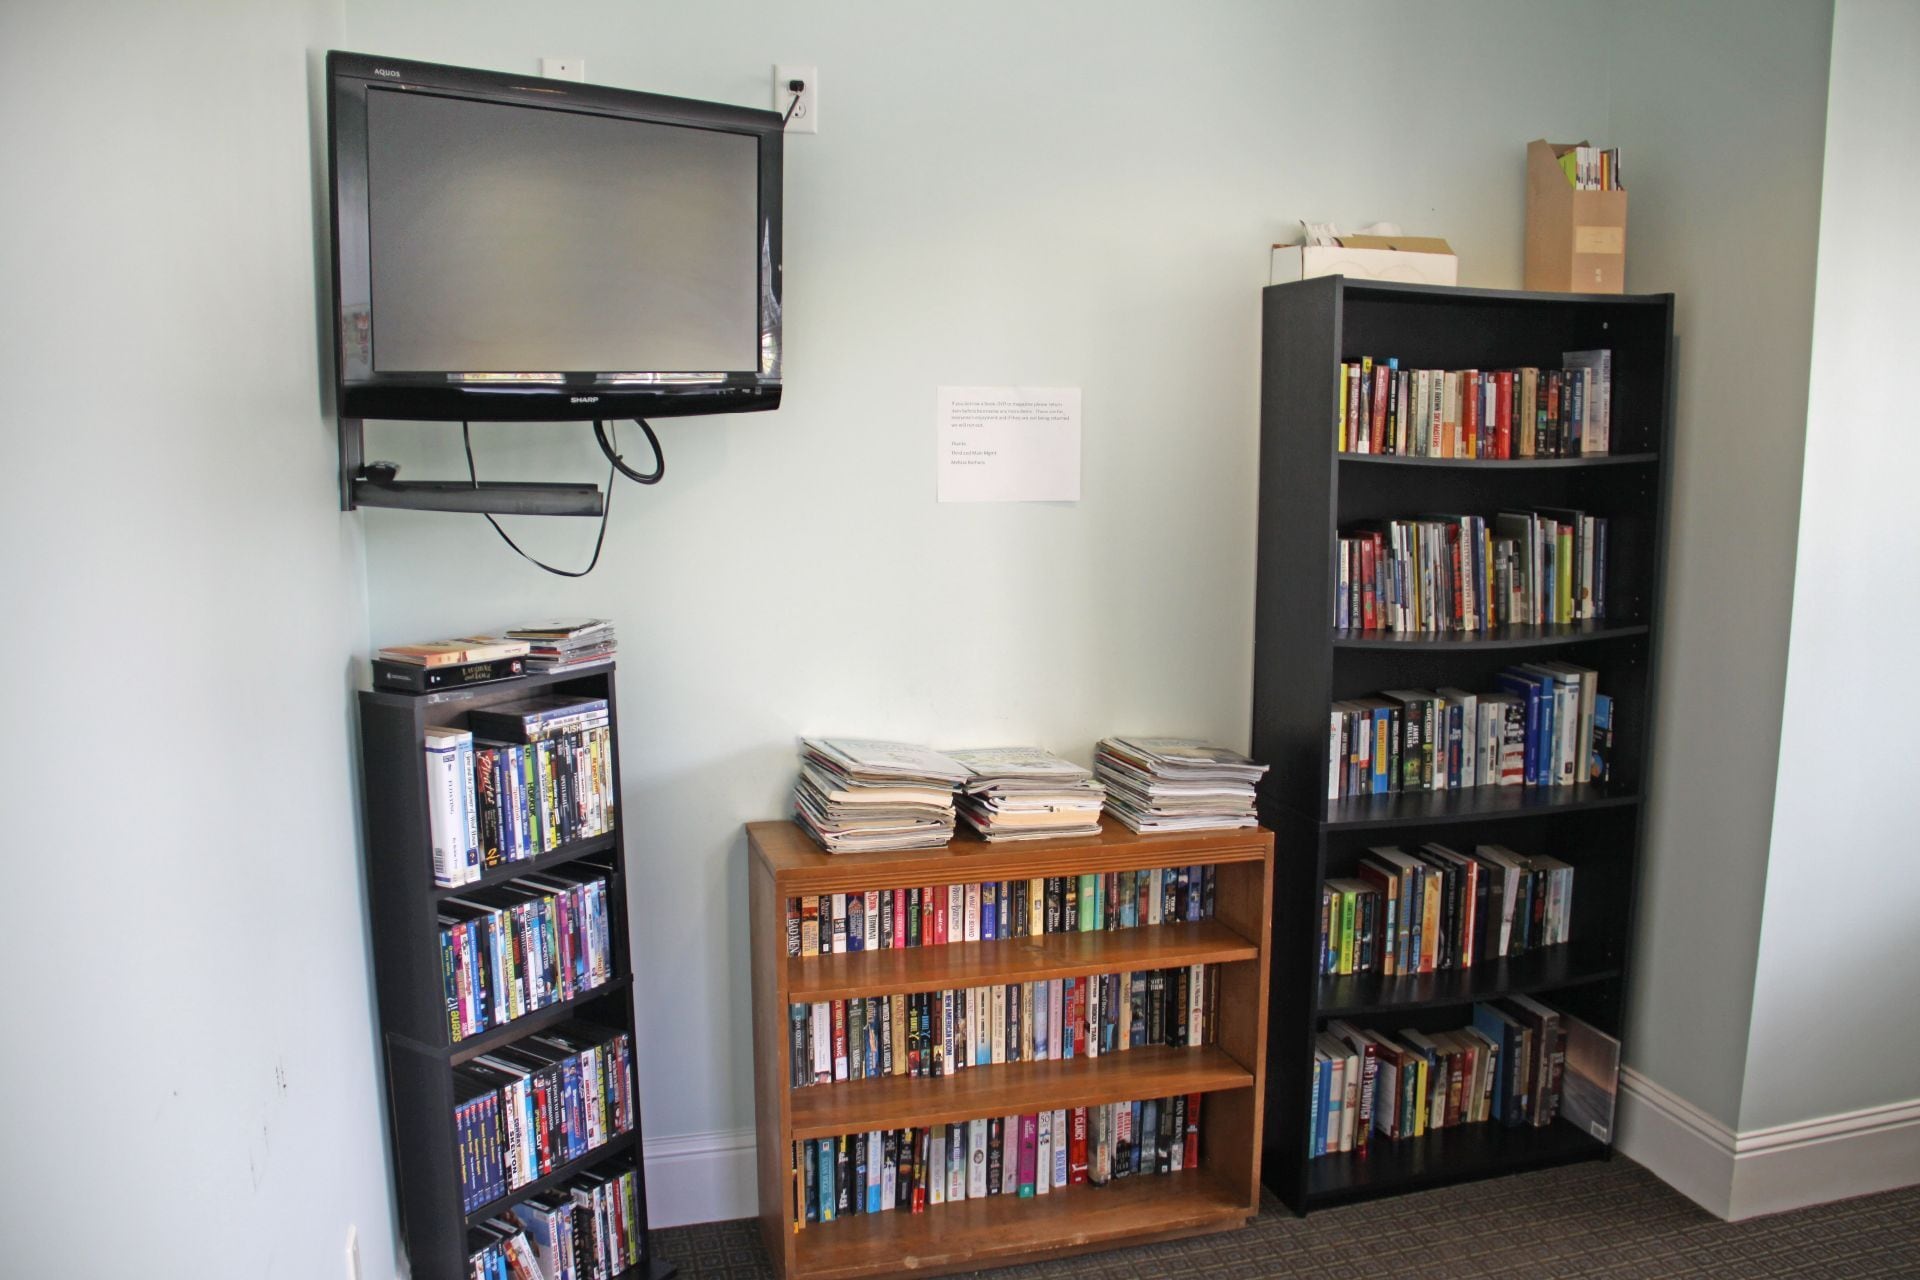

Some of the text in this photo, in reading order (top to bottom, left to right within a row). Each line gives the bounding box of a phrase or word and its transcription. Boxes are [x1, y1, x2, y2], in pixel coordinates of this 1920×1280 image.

[374, 68, 401, 77] AQUOS
[1434, 378, 1442, 391] DALE
[1433, 411, 1441, 422] SKY
[1432, 423, 1440, 448] MASTERS
[562, 724, 582, 735] PUSH
[479, 756, 495, 805] Pirates
[788, 918, 801, 954] BAD MEN
[945, 994, 953, 1008] NEW
[451, 1011, 462, 1043] scene
[945, 1008, 953, 1038] AMERICAN
[1360, 1056, 1376, 1120] JANET EVANOVICH
[1074, 1117, 1085, 1141] CLANCY
[1175, 1100, 1184, 1141] DAN BROWN
[509, 1130, 519, 1175] SKELTON
[535, 1134, 543, 1150] CUT
